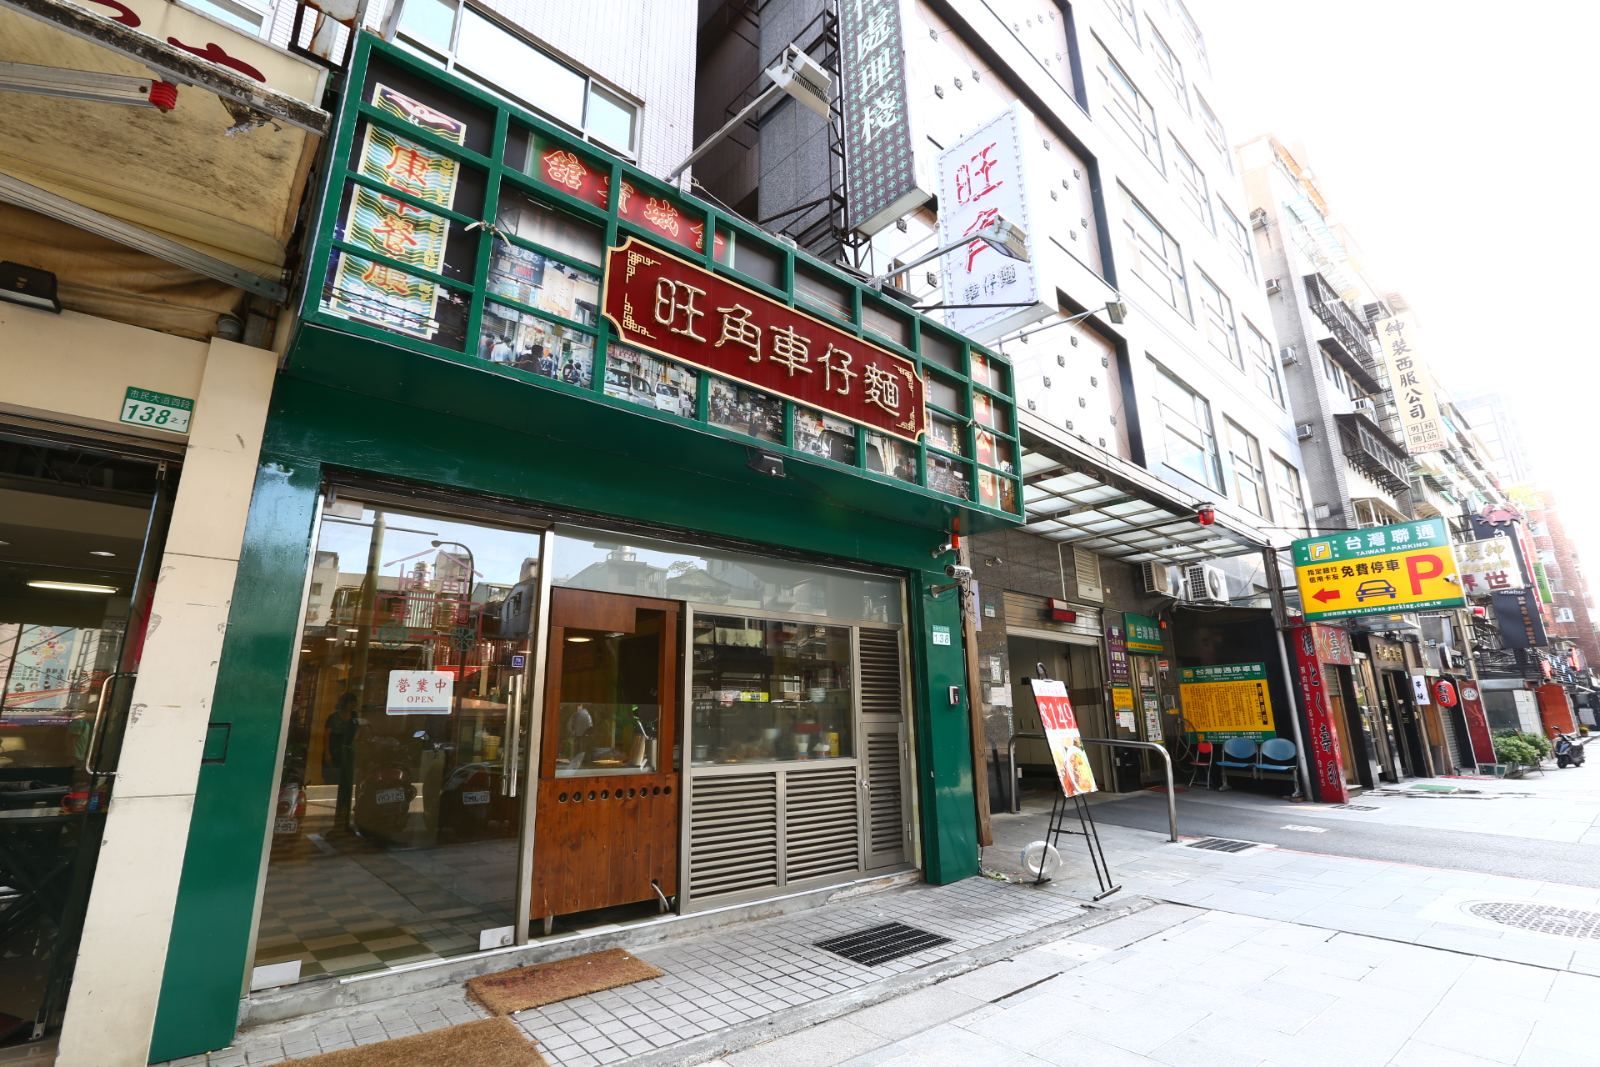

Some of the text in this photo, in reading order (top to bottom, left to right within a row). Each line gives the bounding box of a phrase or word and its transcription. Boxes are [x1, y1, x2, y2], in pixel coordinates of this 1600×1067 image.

[655, 276, 900, 417] 旺角車仔麵
[1385, 320, 1426, 420] 紳裝西服公司
[130, 389, 191, 409] 市民大道四段
[1345, 524, 1436, 550] 台灣聯通
[1355, 541, 1429, 557] TAIWAN PARKING
[1341, 559, 1400, 578] 免費停車
[1405, 554, 1444, 596] P
[1347, 600, 1442, 614] www.taiwan-parking.com.tw
[396, 678, 447, 694] 營業中
[407, 696, 434, 704] OPEN
